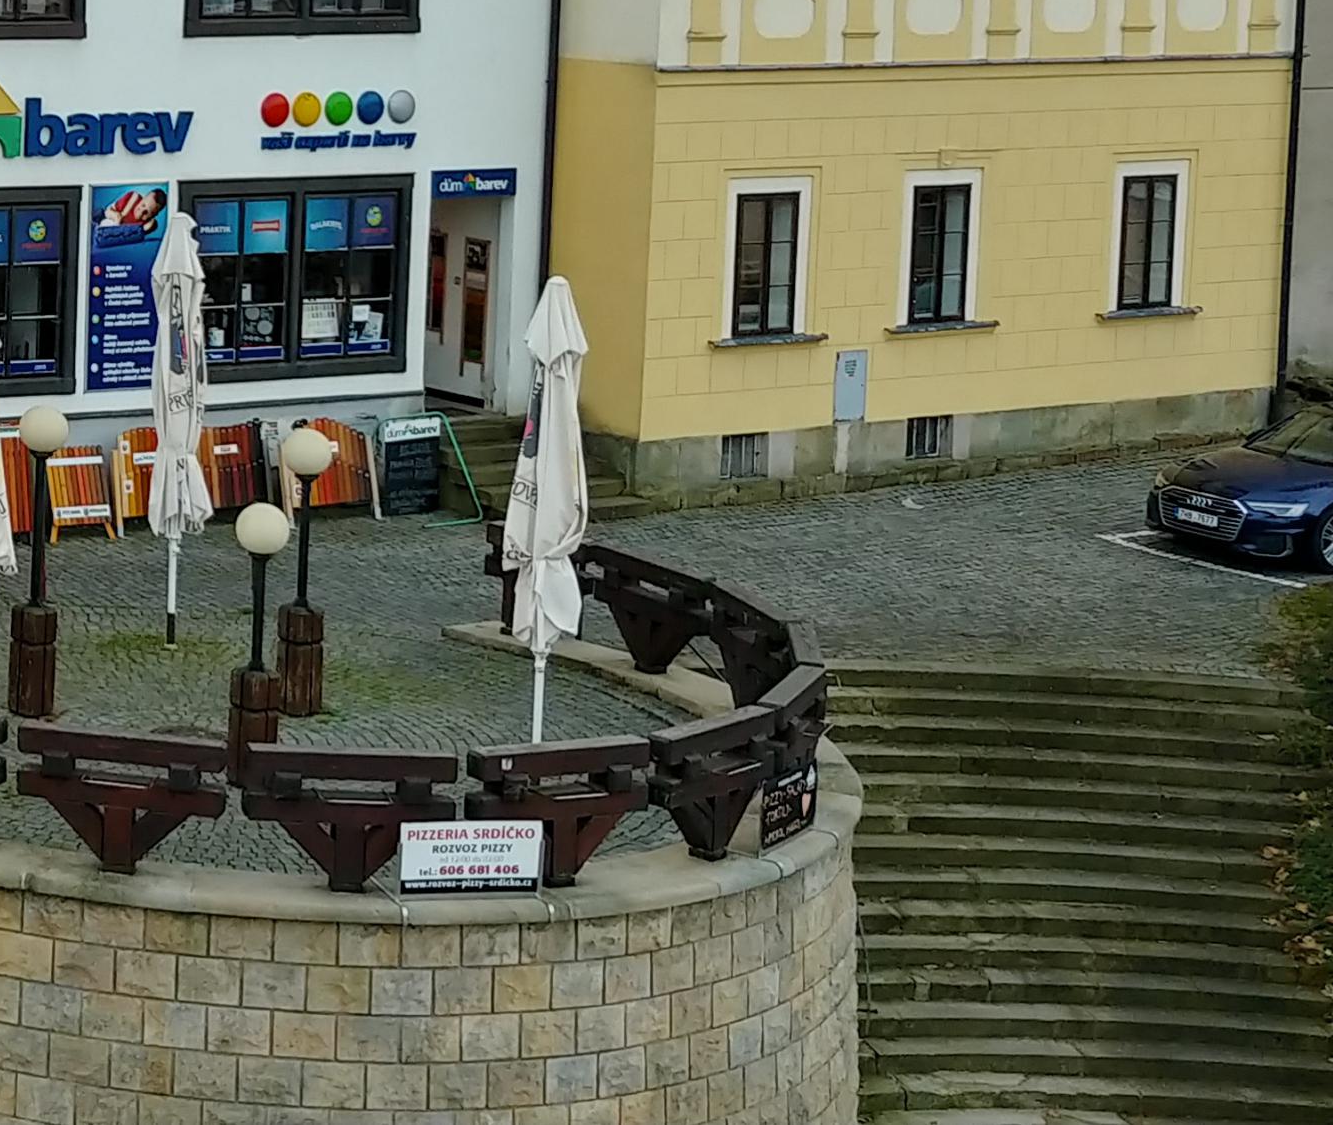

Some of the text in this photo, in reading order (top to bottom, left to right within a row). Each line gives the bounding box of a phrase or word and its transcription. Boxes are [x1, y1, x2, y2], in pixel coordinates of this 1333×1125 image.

[24, 97, 194, 158] barev
[439, 177, 509, 193] dům barev
[407, 826, 536, 841] PIZZERIA SRDÍČKO
[432, 843, 513, 854] ROZVOZ PIZZY
[419, 864, 520, 876] tel.: 606 681 406
